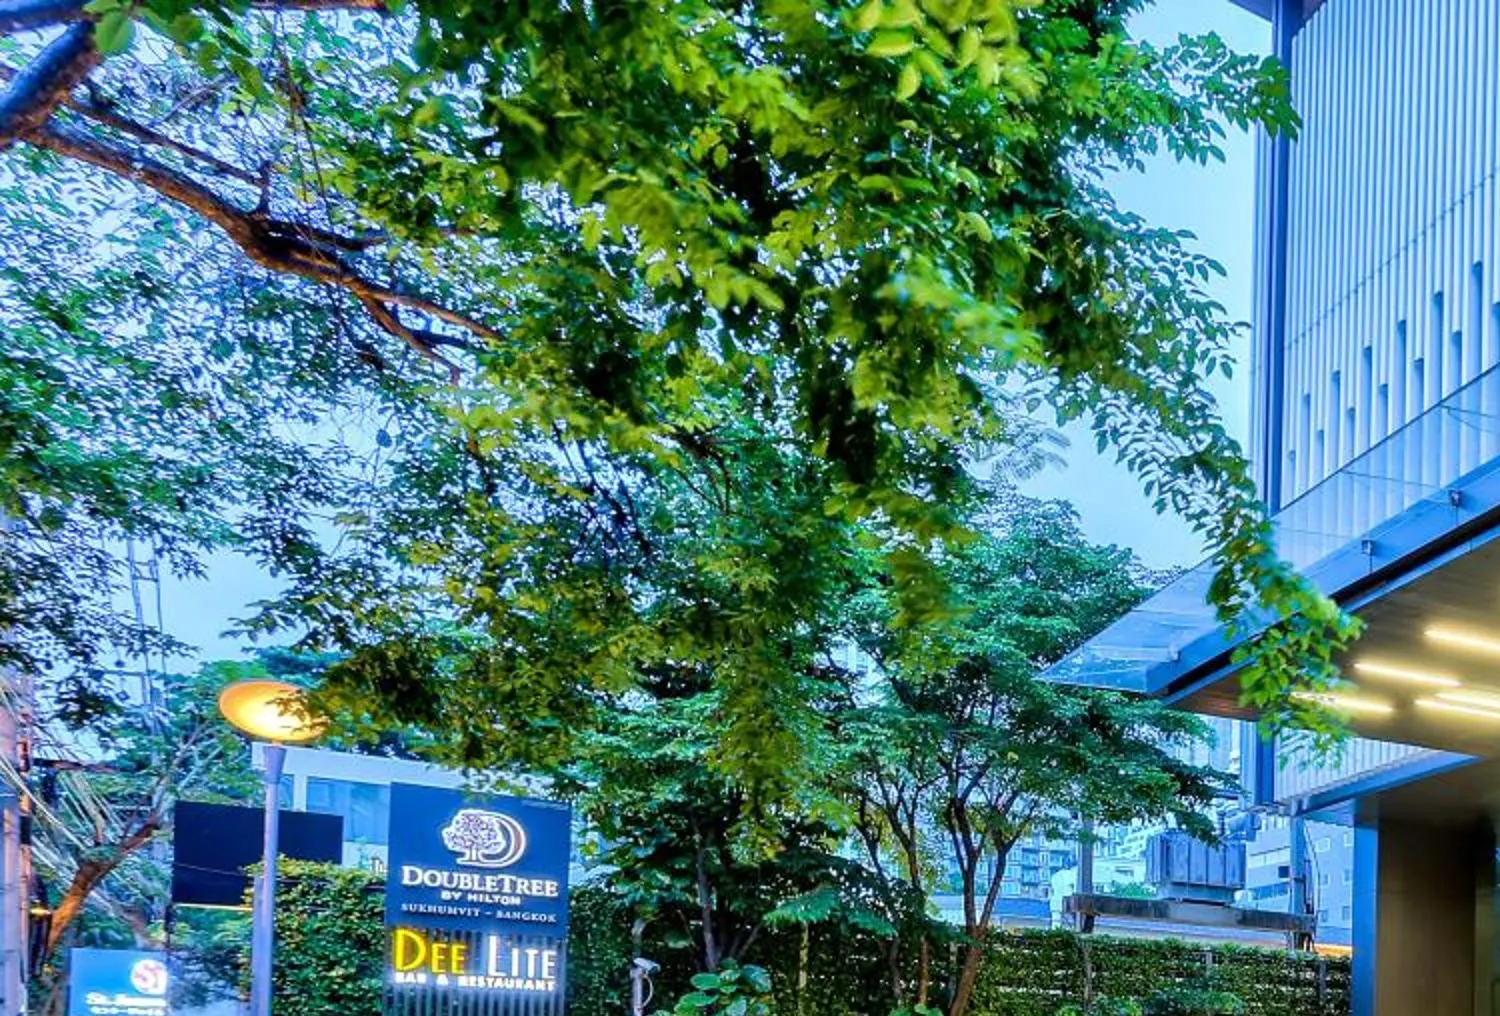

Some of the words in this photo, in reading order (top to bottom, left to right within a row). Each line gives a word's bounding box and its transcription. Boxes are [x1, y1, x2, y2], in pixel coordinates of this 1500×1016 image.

[401, 865, 560, 897] DOUBLETREE
[441, 890, 462, 901] BY
[467, 892, 522, 906] HILTON
[401, 902, 481, 917] SUKHUMVIT
[495, 909, 558, 923] BANGKOK
[394, 928, 468, 975] DEE
[487, 934, 558, 980] LITE
[395, 971, 428, 985] BAR
[457, 974, 557, 992] RESTAURANT
